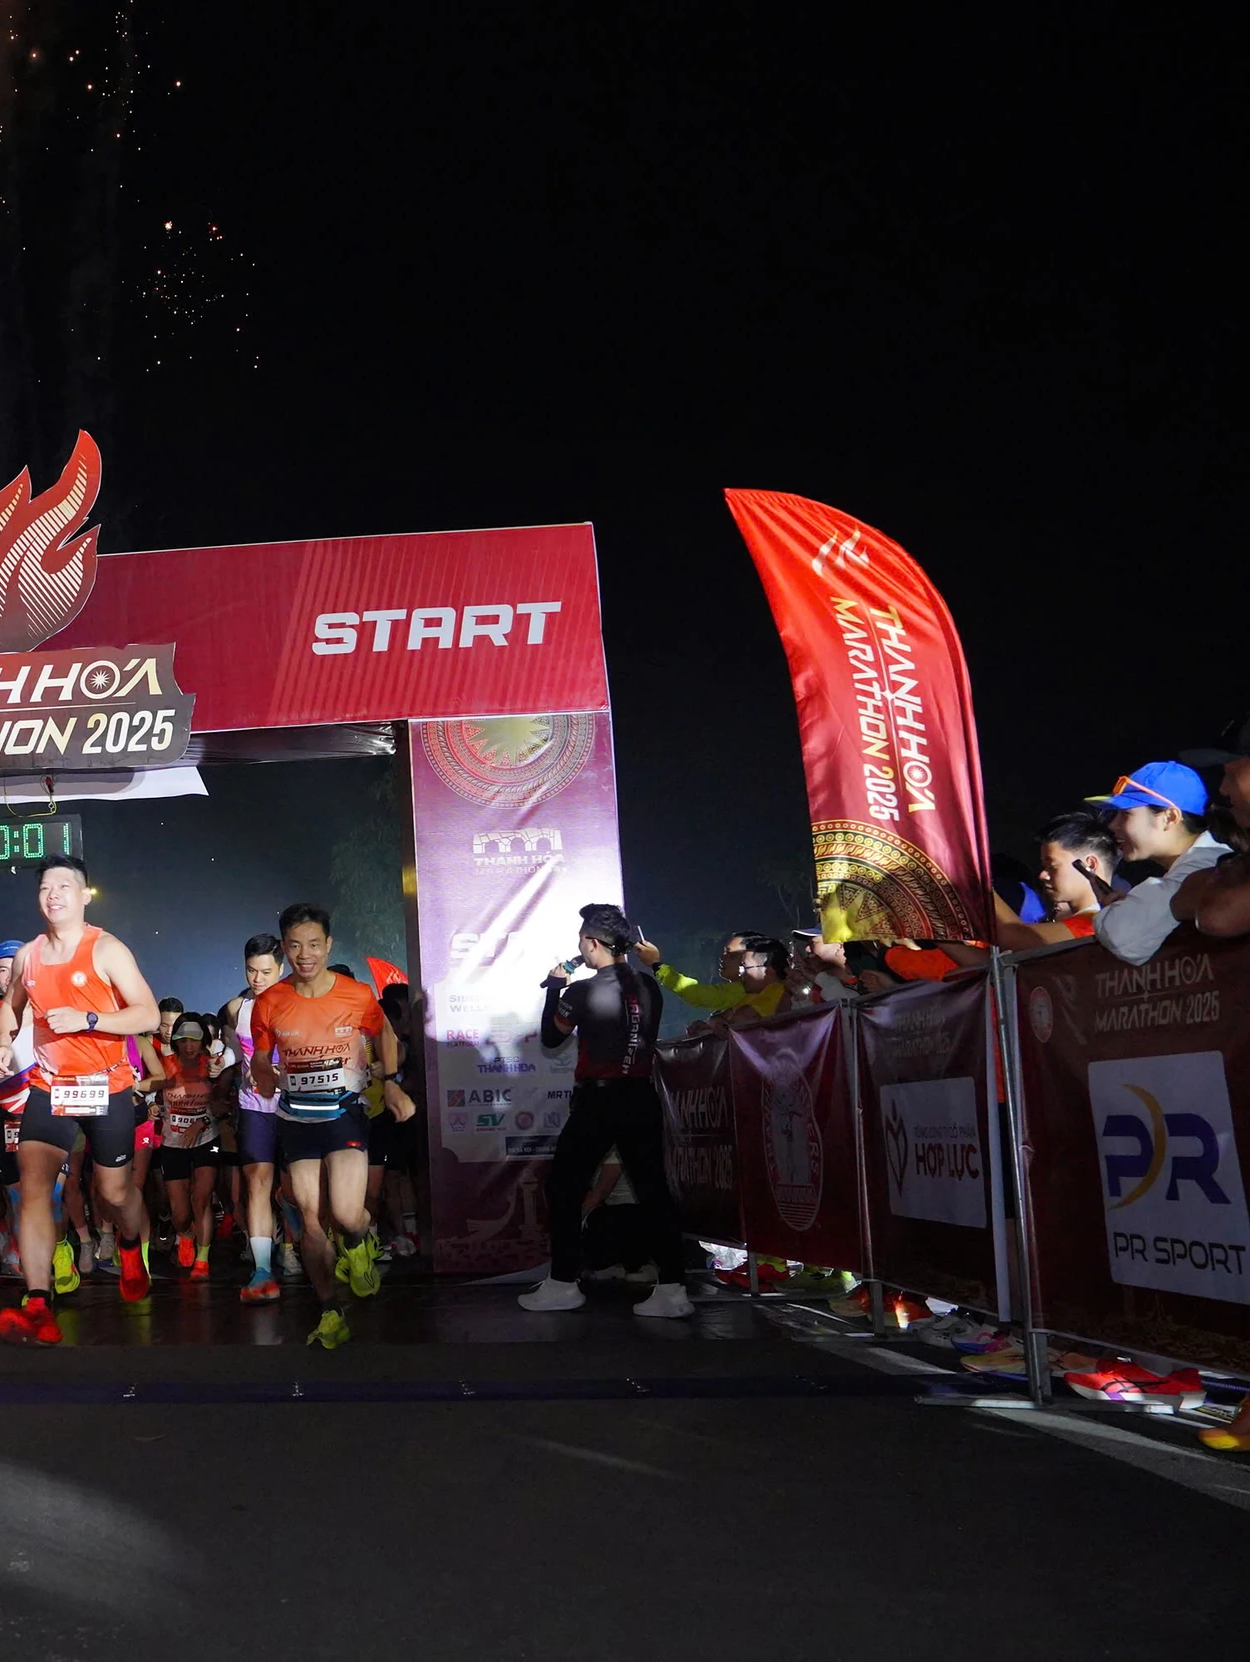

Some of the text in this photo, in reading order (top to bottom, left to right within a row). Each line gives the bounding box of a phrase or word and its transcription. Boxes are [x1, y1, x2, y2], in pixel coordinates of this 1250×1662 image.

[310, 601, 562, 656] START
[870, 604, 926, 731] THANH
[830, 596, 900, 822] MARATHON 2025
[82, 709, 176, 755] 2025
[1094, 961, 1162, 998] THANH
[1093, 998, 1183, 1034] MARATHON
[1185, 990, 1221, 1025] 2025
[283, 1045, 323, 1058] THANH
[446, 1029, 479, 1041] RACE
[63, 1090, 105, 1099] 99699
[301, 1073, 339, 1085] 97515
[469, 1089, 512, 1103] ABIC
[476, 1114, 506, 1127] SV
[1102, 1113, 1232, 1205] PR
[1113, 1232, 1246, 1275] PR SPORT
